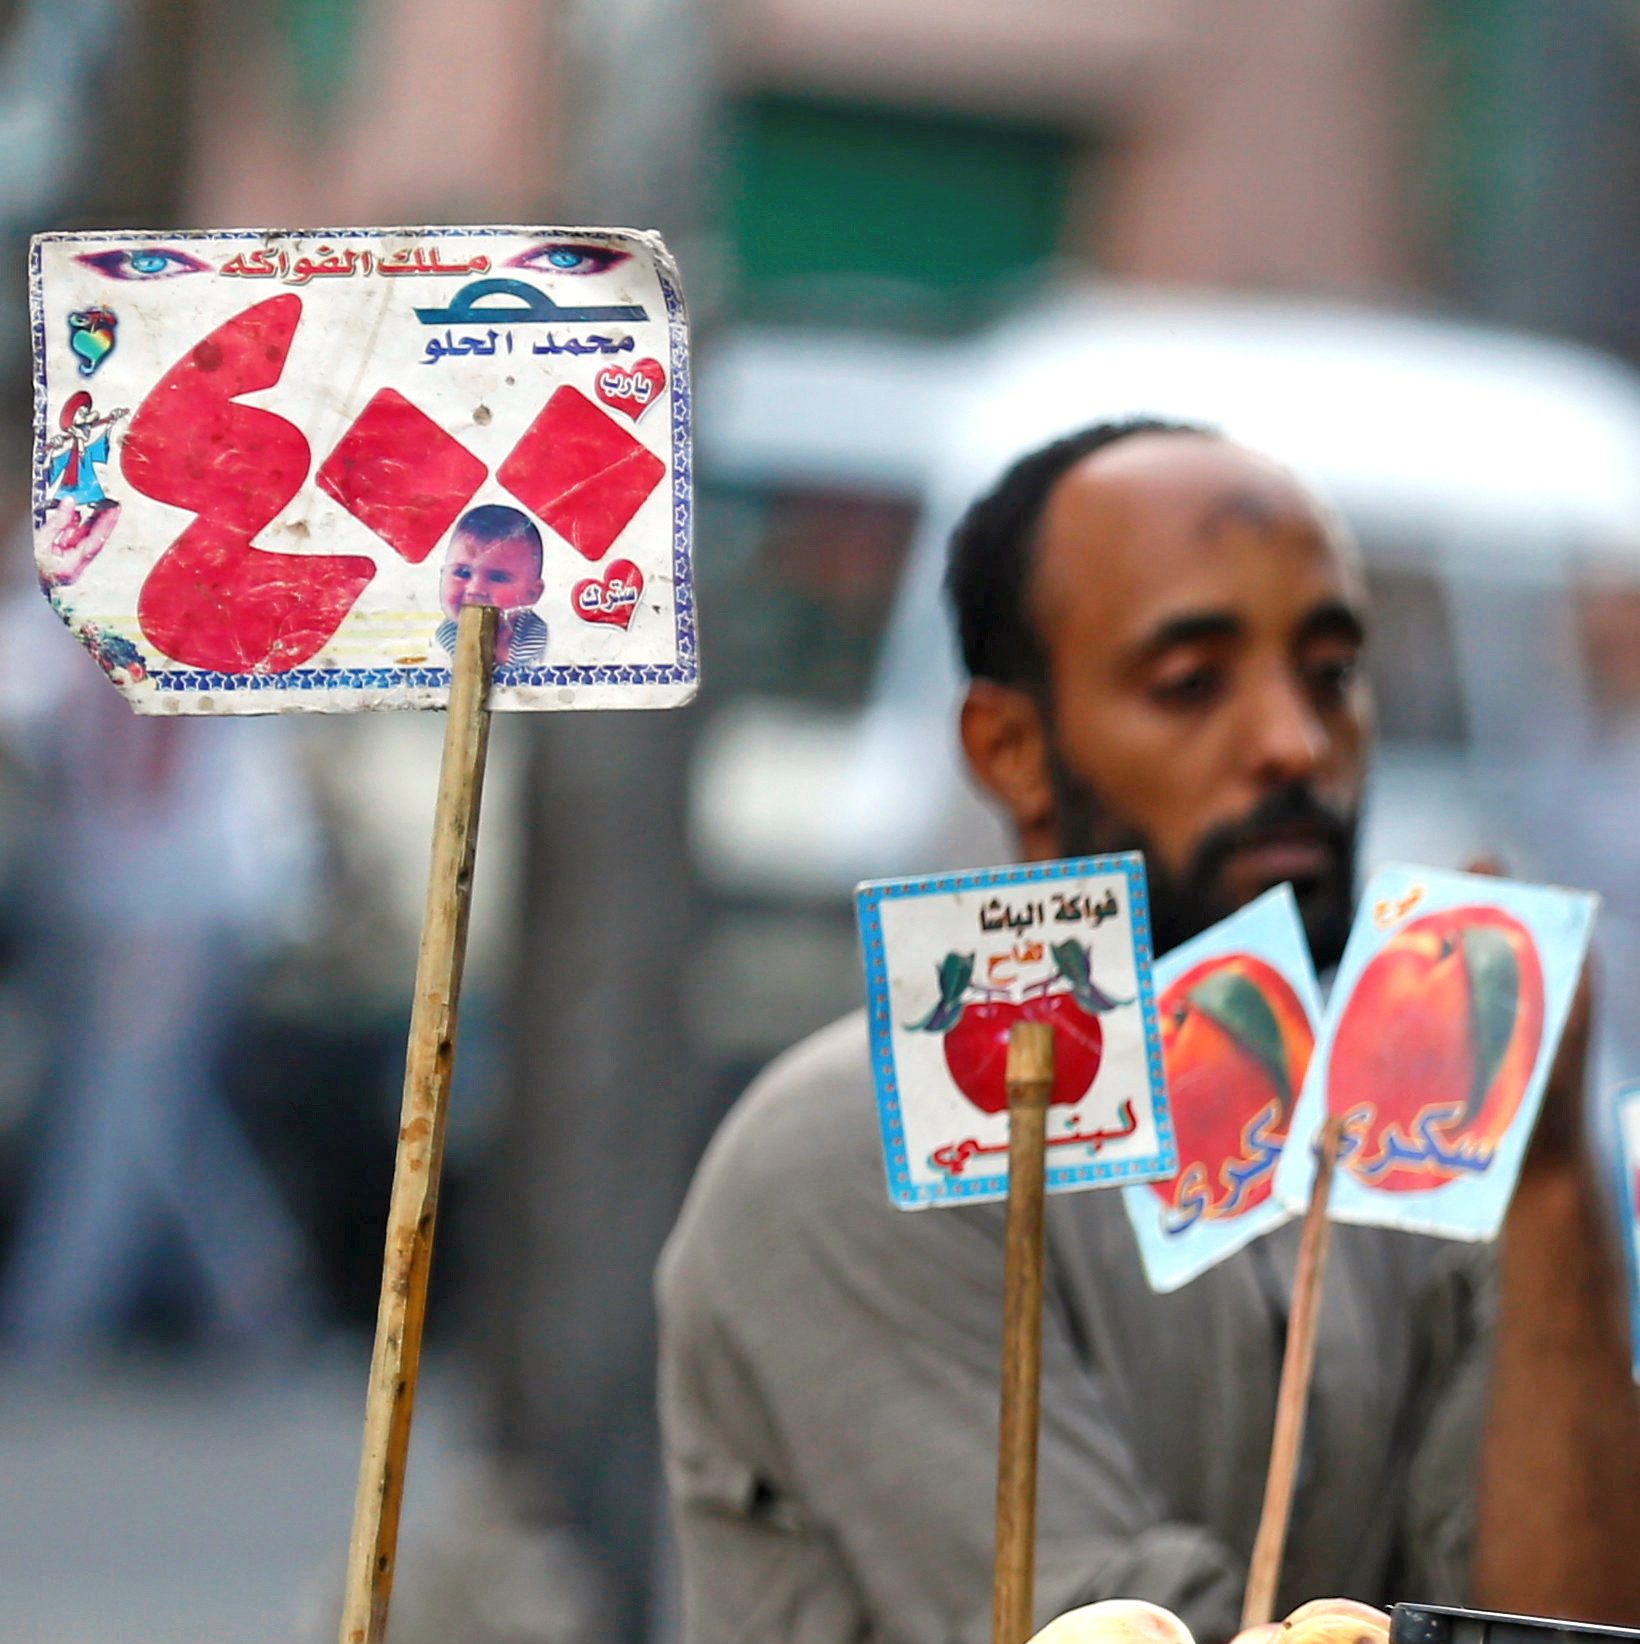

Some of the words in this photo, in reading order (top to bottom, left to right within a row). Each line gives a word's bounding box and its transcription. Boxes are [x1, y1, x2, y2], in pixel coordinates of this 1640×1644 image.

[377, 246, 491, 277] ملك
[419, 327, 512, 365] الحلو
[532, 332, 635, 357] محمد
